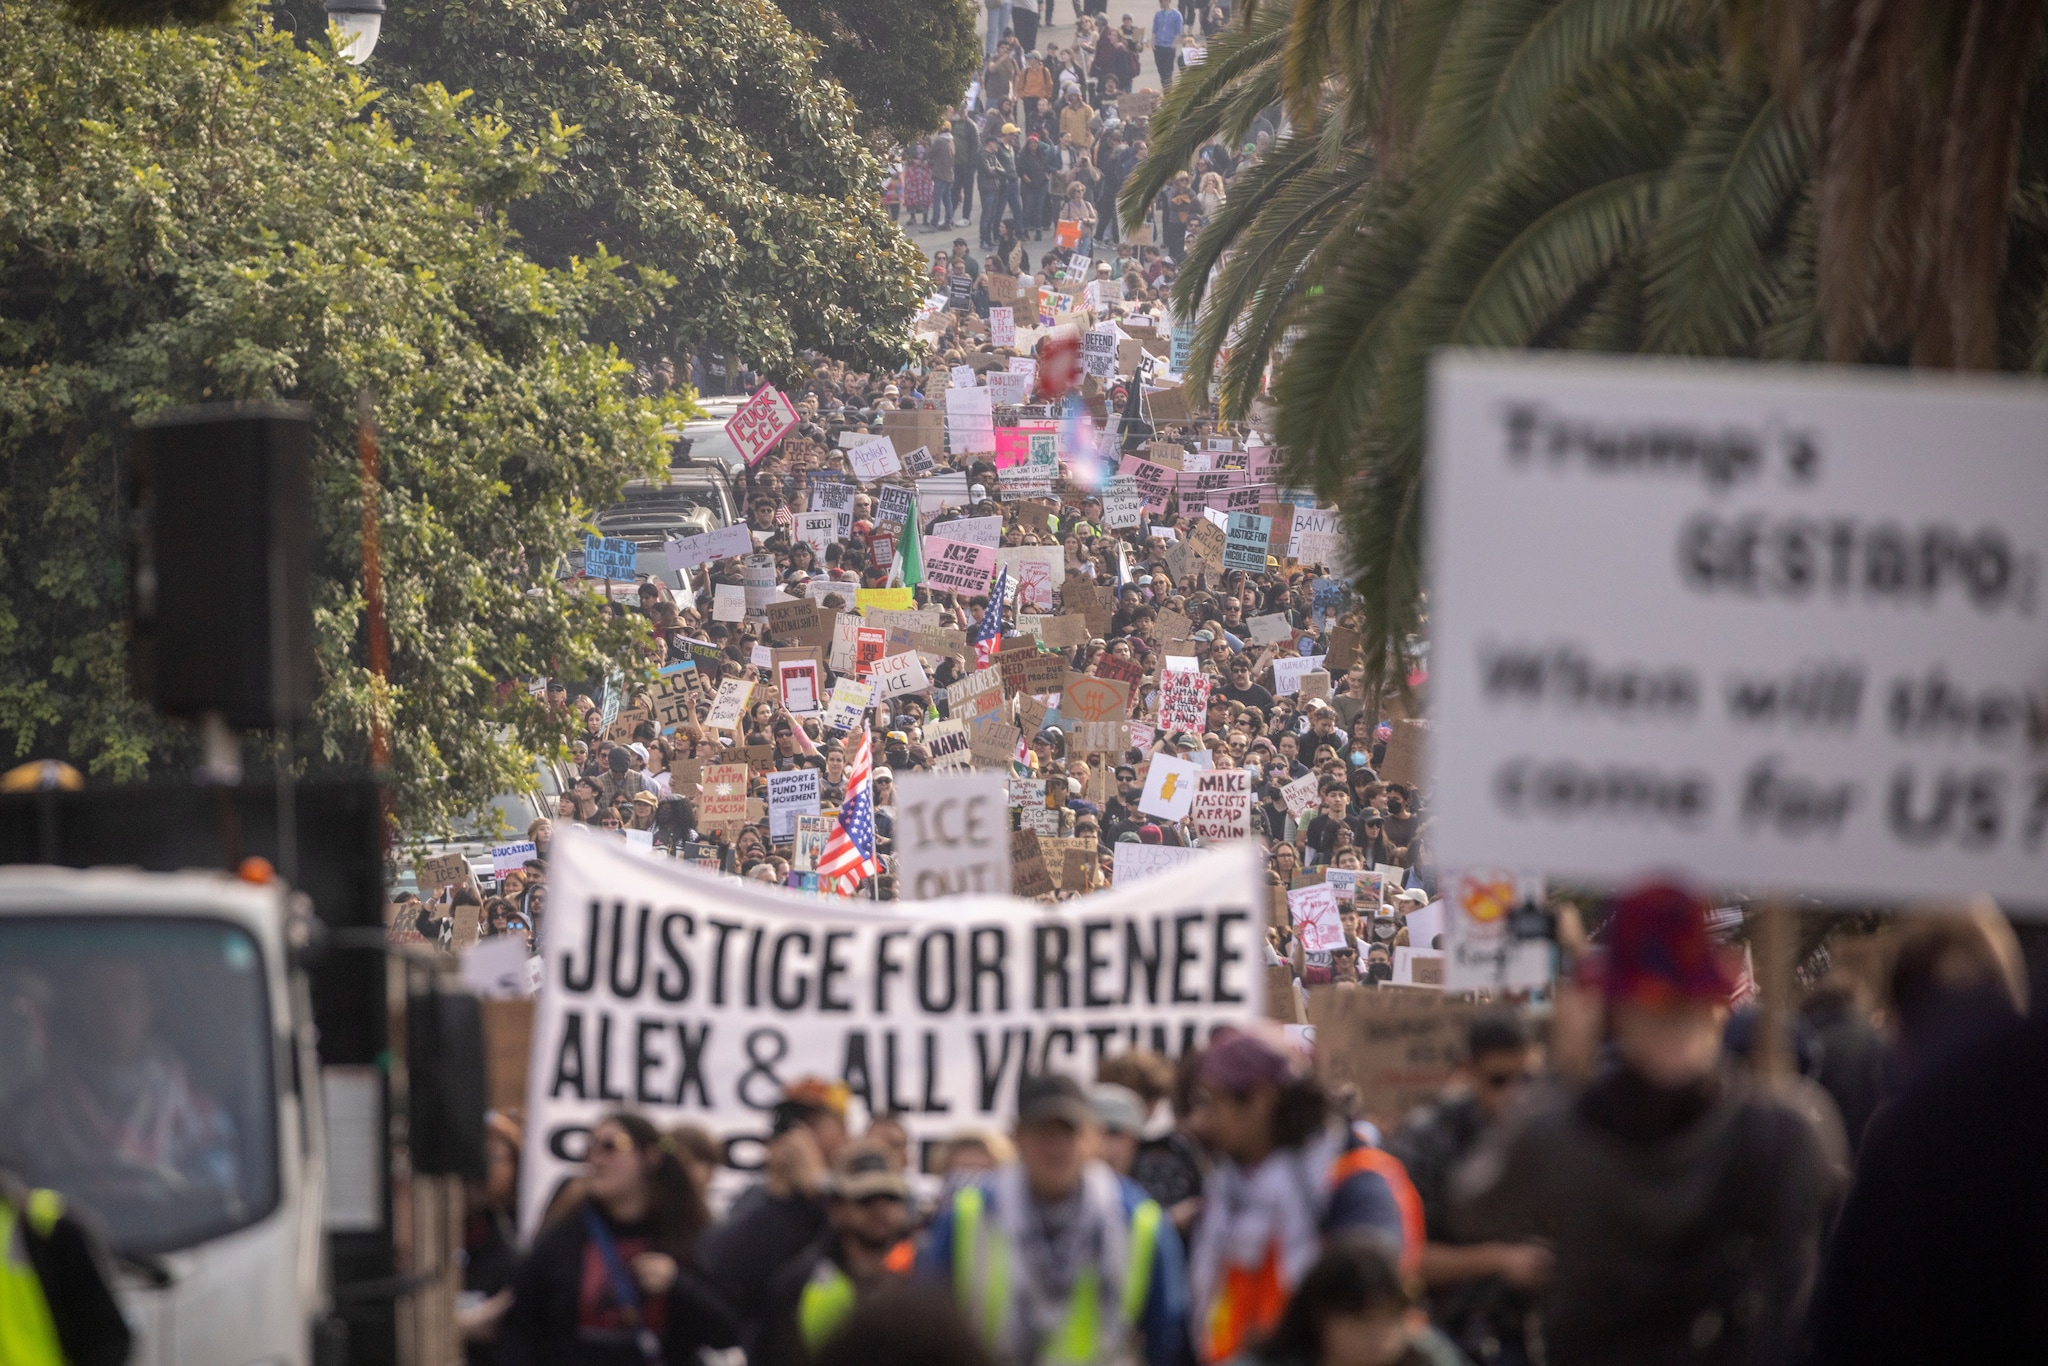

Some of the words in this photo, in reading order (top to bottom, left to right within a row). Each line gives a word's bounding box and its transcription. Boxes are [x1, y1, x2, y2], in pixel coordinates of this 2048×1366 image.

[992, 309, 1011, 319] THIS
[992, 326, 1013, 335] STATE
[1085, 333, 1114, 347] DEFEND
[989, 376, 1020, 387] ABOLISH
[990, 388, 1008, 397] ICE
[732, 391, 777, 442] FUCK
[746, 411, 784, 455] ICE
[786, 441, 811, 452] FUCK
[1498, 398, 1826, 494] Trump's
[789, 453, 809, 461] ICE
[854, 444, 888, 466] Abolish
[912, 449, 927, 462] OUT
[1216, 454, 1248, 469] ICE
[862, 457, 893, 478] ICE
[1135, 463, 1164, 482] ICE
[815, 482, 827, 491] IT'S
[827, 484, 842, 493] TIME
[842, 487, 854, 495] FOR
[1196, 474, 1230, 490] ICE
[823, 493, 849, 503] GENERAL
[883, 487, 913, 504] DEFEN
[1227, 490, 1260, 508] ICE
[822, 500, 845, 510] STRIKE!
[1106, 502, 1138, 513] STOLEN
[878, 510, 889, 520] IT'S
[889, 512, 903, 523] TIME
[1110, 513, 1136, 525] LAND
[806, 519, 832, 529] STOP
[936, 523, 963, 535] JESUS
[1294, 515, 1326, 533] BAN
[1228, 527, 1255, 541] JUSTICE
[1255, 530, 1268, 543] FOR
[589, 537, 600, 550] NO
[604, 540, 624, 554] ONE
[626, 542, 636, 555] IS
[1195, 532, 1221, 556] KILLIN
[1226, 543, 1266, 555] RENEE
[587, 551, 618, 564] ILLEGAL
[618, 554, 632, 567] ON
[943, 544, 980, 565] ICE
[1225, 550, 1248, 562] NICOLE
[1247, 553, 1265, 565] GOOD
[587, 563, 616, 577] STOLEN
[926, 558, 990, 580] DESTROYS
[928, 571, 985, 591] FAMILIES
[770, 608, 790, 620] FUCK
[794, 604, 812, 616] THIS
[883, 615, 920, 626] PRISON
[1020, 615, 1041, 625] ENOU
[770, 622, 787, 634] NAZI
[690, 644, 721, 659] EXISTENCE
[862, 643, 878, 653] JAIL
[684, 652, 692, 660] OR
[863, 652, 876, 661] ICE
[873, 656, 910, 676] FUCK
[1001, 663, 1024, 675] NEED
[1047, 665, 1064, 673] DUE
[784, 668, 813, 679] STOP
[1002, 674, 1027, 687] YOUR
[1028, 673, 1058, 682] PROCESS
[653, 669, 699, 700] ICE
[886, 674, 911, 692] ICE
[947, 681, 965, 706] OPEN
[963, 671, 983, 697] YOUR
[981, 664, 1000, 692] EYES
[1176, 675, 1190, 687] NO
[1476, 636, 1704, 712] When
[1721, 655, 1866, 728] will
[1165, 687, 1199, 696] HUMAN
[964, 699, 978, 720] WAS
[977, 689, 1003, 713] MURDER
[1176, 705, 1201, 713] STOLEN
[624, 712, 645, 722] THE
[661, 703, 690, 726] ID
[834, 714, 855, 726] ICE
[1170, 714, 1196, 723] LAND
[720, 749, 752, 762] FUCK
[717, 766, 732, 774] AM
[750, 759, 769, 770] CE
[705, 773, 744, 784] ANTIFA
[770, 775, 809, 786] SUPPORT
[809, 773, 816, 781] &
[1199, 773, 1246, 792] MAKE
[772, 785, 798, 796] FUND
[799, 782, 816, 793] THE
[1284, 784, 1298, 795] WE
[1285, 781, 1317, 802] PROTECT
[1492, 756, 1708, 826] come
[1738, 748, 1853, 838] for
[772, 792, 817, 804] MOVEMENT
[1195, 794, 1247, 808] FASCISTS
[1294, 797, 1305, 806] US
[705, 805, 744, 814] FASCISM
[1024, 808, 1049, 819] STOP
[800, 817, 836, 832] MELT
[905, 794, 993, 849] ICE
[1198, 823, 1244, 839] AGAIN
[492, 843, 536, 858] EDUCATION
[698, 847, 718, 857] ICE
[1139, 846, 1172, 866] USES
[422, 858, 450, 870] MELT
[435, 867, 461, 883] ICE!
[1115, 865, 1140, 881] TAX
[794, 870, 840, 892] TINY
[912, 864, 997, 900] OUT
[560, 897, 854, 1015] JUSTICE
[872, 922, 1010, 1016] FOR
[1031, 908, 1250, 1011] RENEE
[549, 1008, 712, 1108] ALEX
[736, 1025, 790, 1110] &
[840, 1024, 950, 1117] ALL
